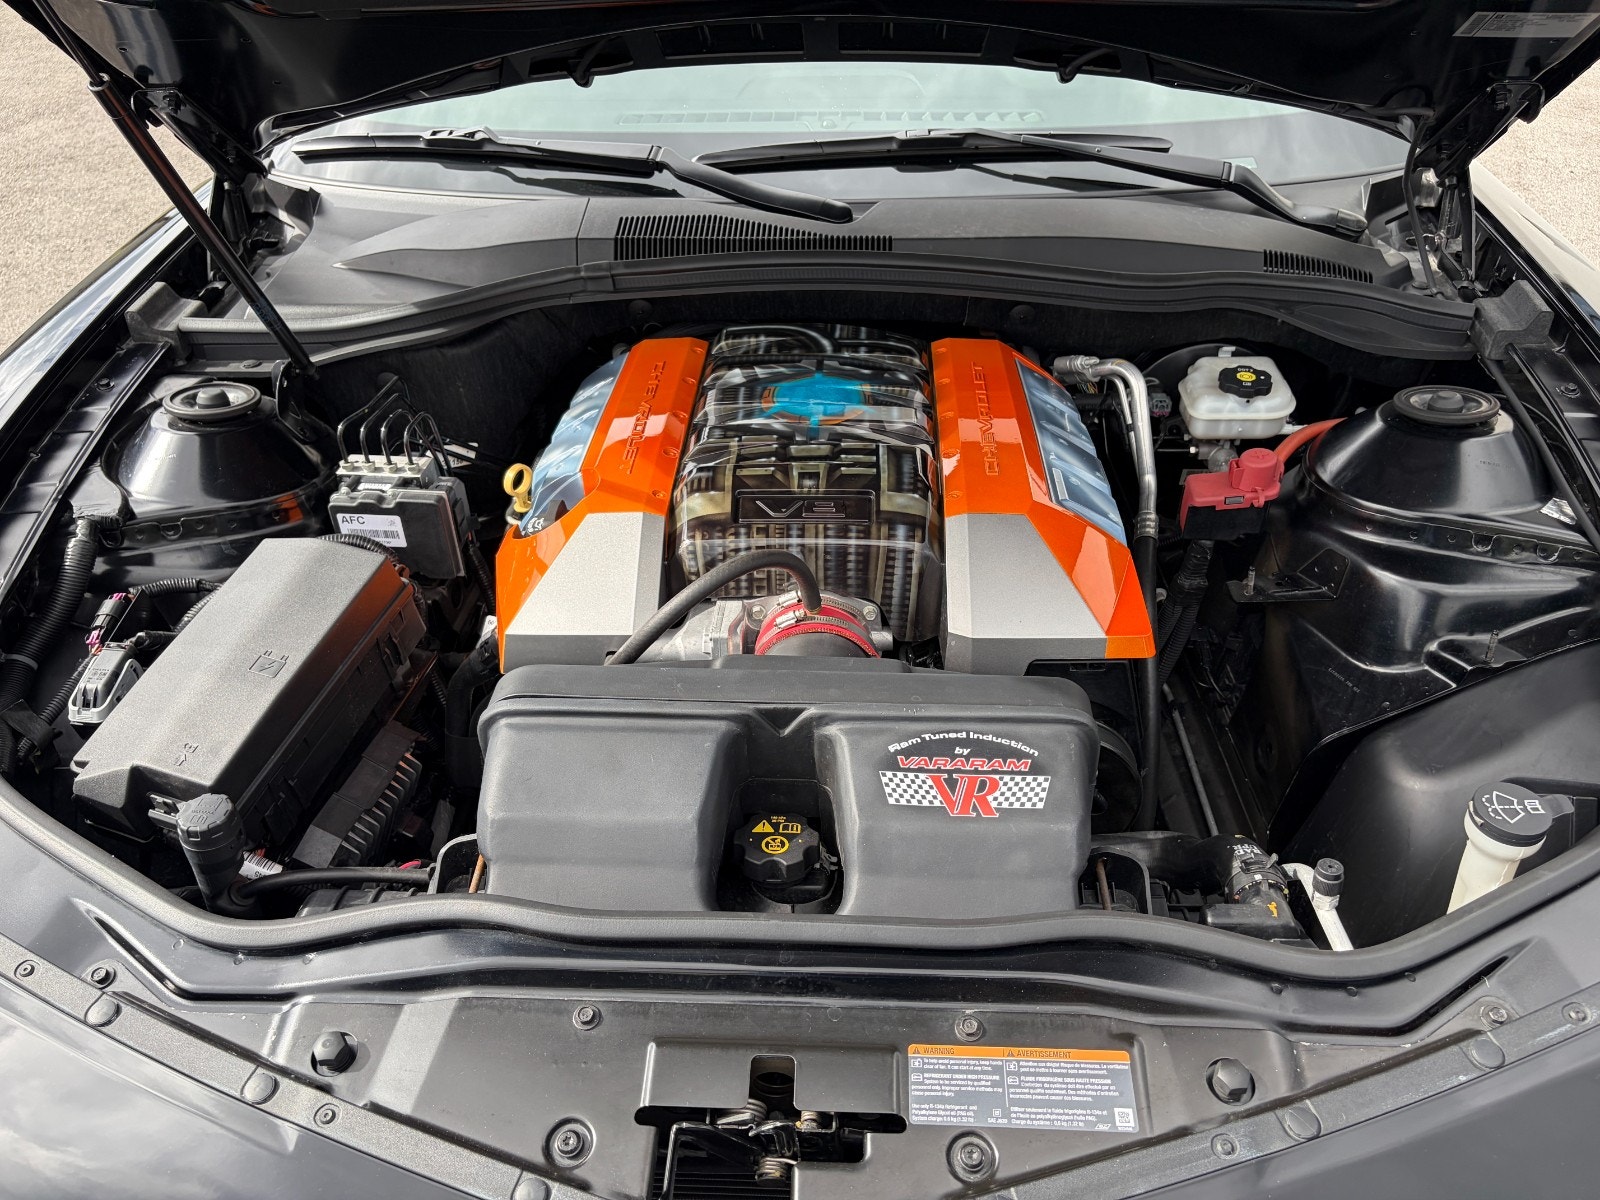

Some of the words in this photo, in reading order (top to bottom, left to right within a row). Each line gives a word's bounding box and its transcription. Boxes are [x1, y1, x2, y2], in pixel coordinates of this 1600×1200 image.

[619, 361, 666, 474] CHEVROLET
[971, 362, 999, 475] CHEVROLET
[756, 500, 845, 517] V8
[342, 515, 365, 525] AFC
[888, 737, 921, 753] Ram
[921, 731, 966, 741] Tuned
[970, 731, 1039, 757] Induction
[954, 746, 970, 756] by
[897, 756, 1032, 772] VARARAM
[926, 773, 1000, 817] VR
[924, 1047, 954, 1055] WARNING
[1017, 1050, 1071, 1058] AVERTISSEMENT
